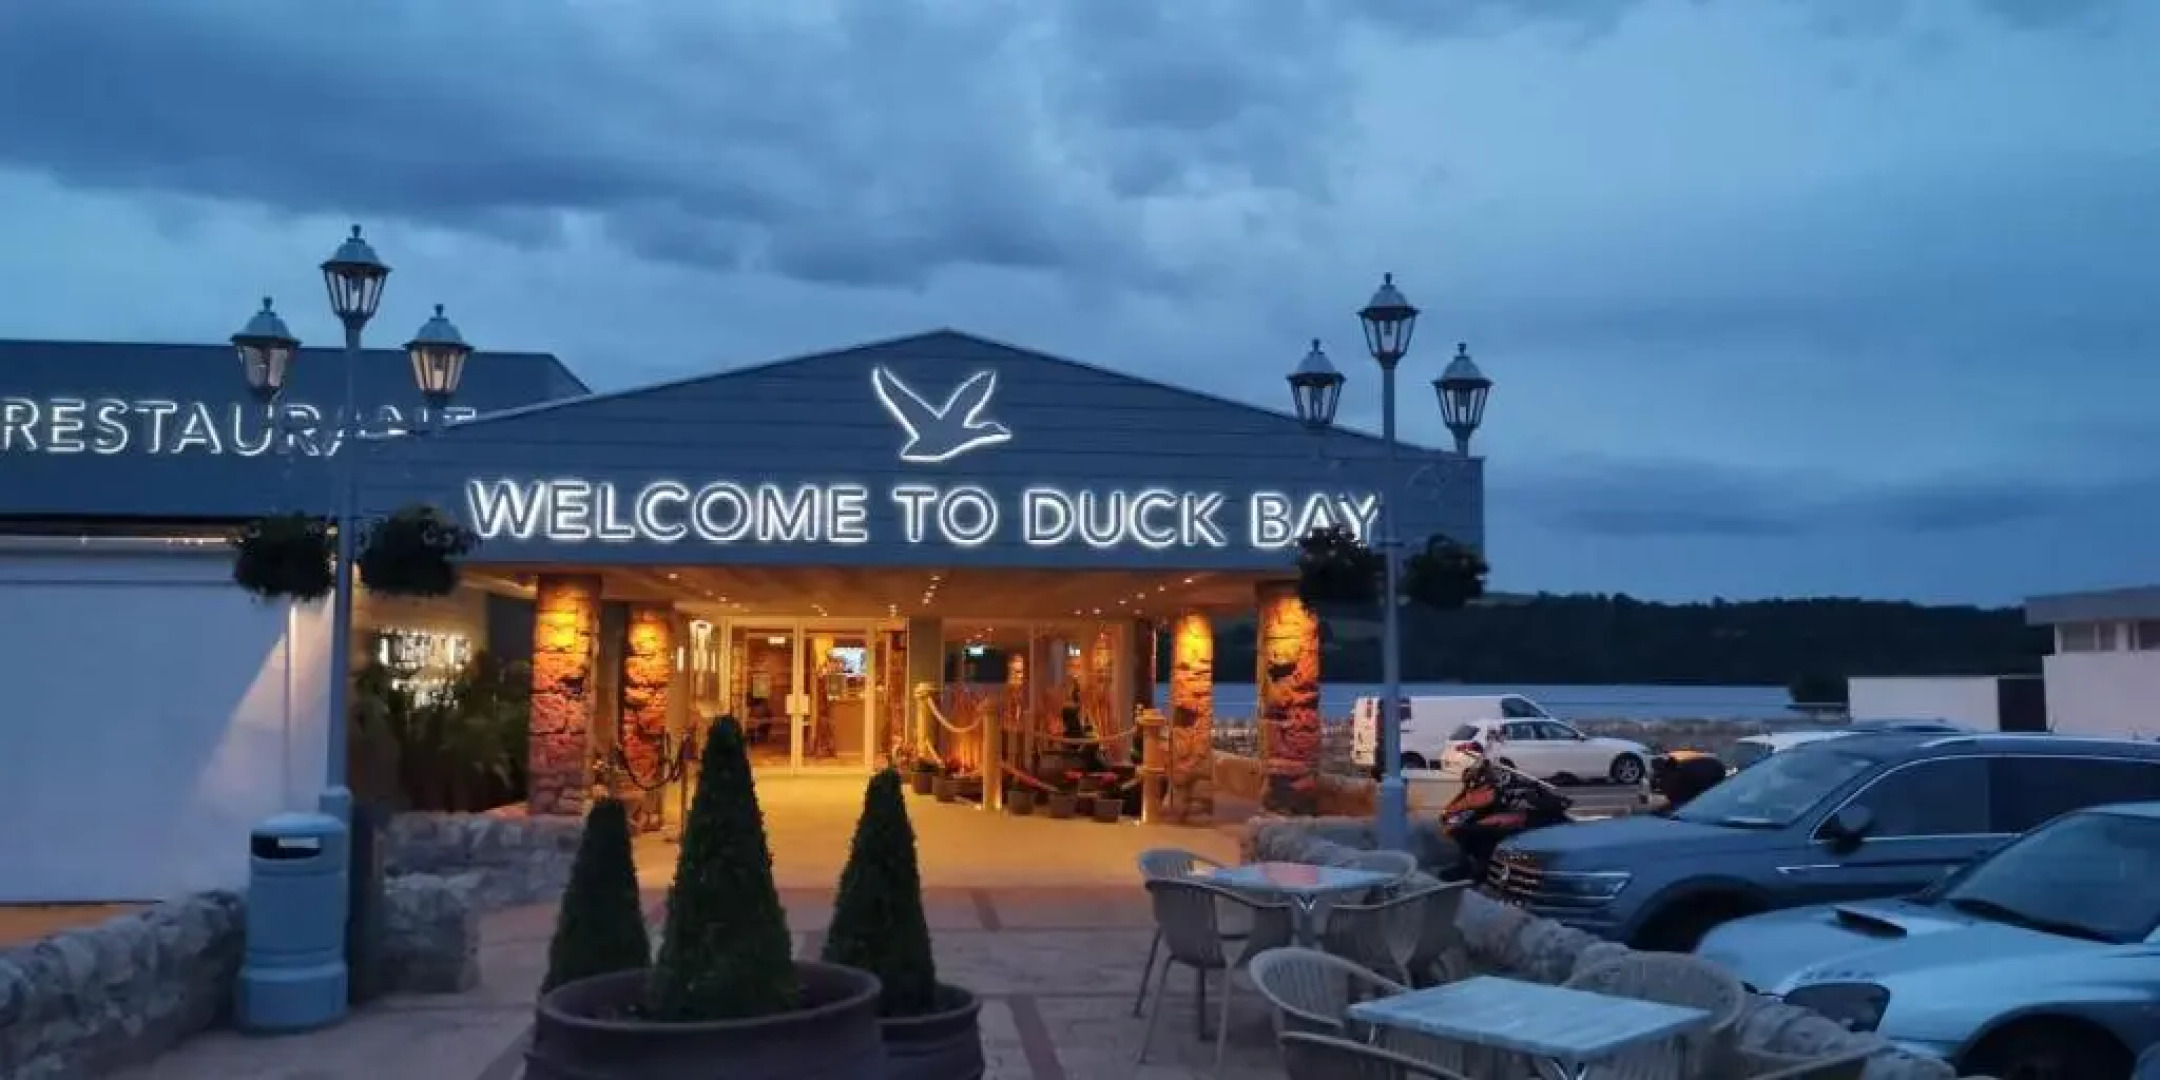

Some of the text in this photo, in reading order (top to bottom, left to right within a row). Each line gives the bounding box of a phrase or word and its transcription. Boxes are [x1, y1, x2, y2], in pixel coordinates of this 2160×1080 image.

[467, 480, 1380, 550] WELCOME TO DUCK BAY
